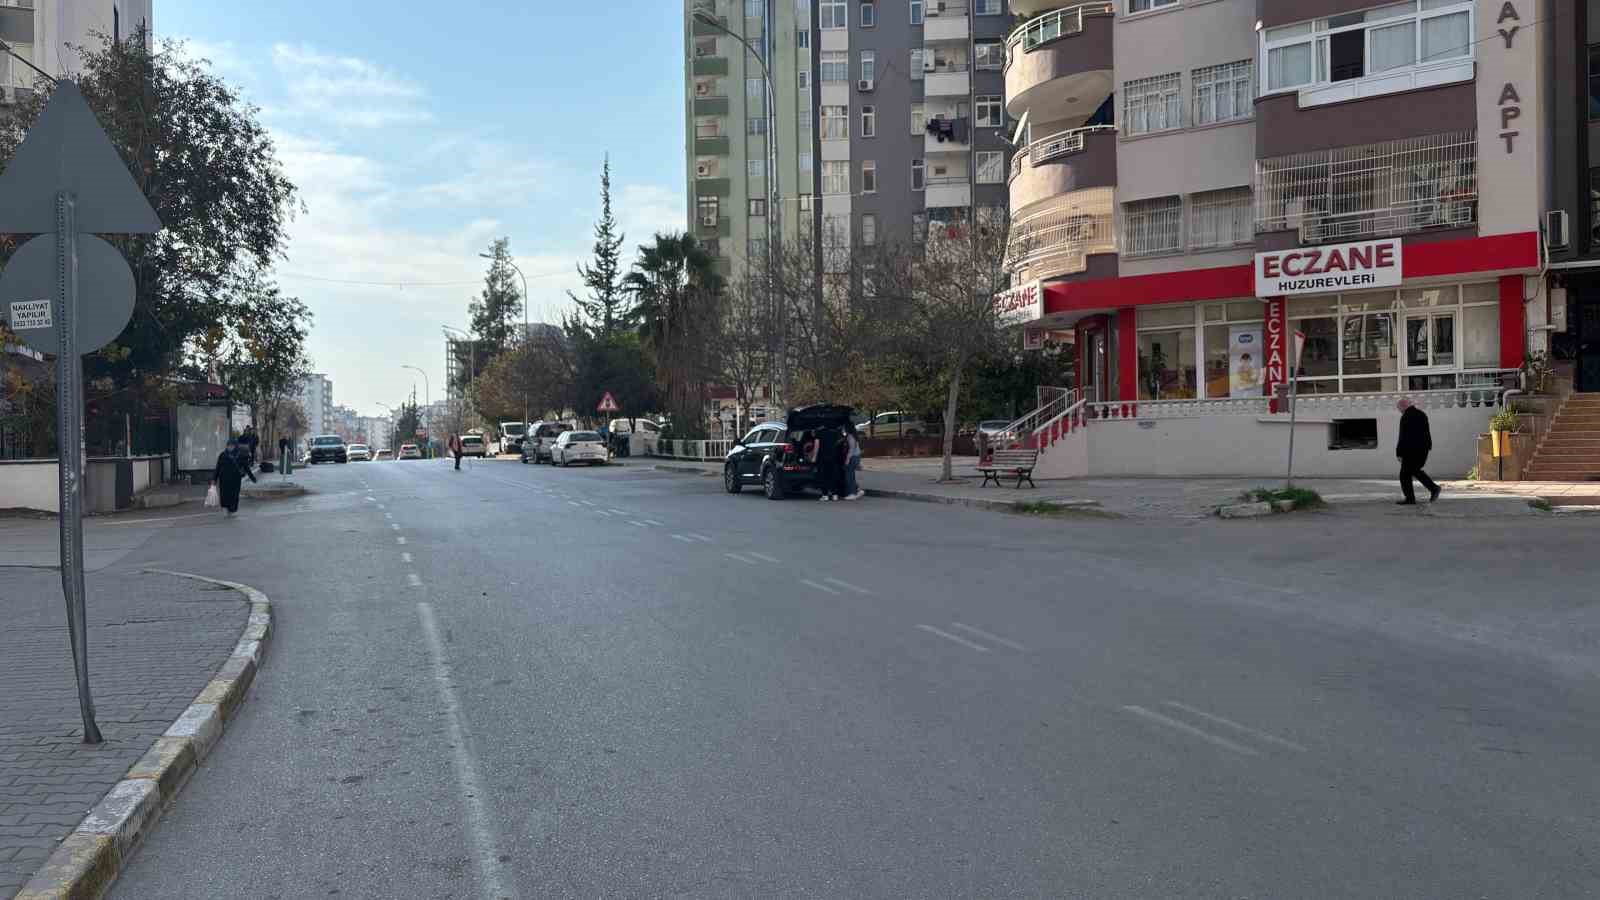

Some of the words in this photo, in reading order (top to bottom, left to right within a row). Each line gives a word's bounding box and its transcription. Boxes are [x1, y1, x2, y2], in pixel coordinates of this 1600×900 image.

[1498, 82, 1521, 154] APT
[1263, 243, 1394, 279] ECZANE
[1278, 273, 1375, 291] HUZUREVLERİ
[17, 311, 46, 319] YAPILIR
[1268, 302, 1282, 400] ECZANE
